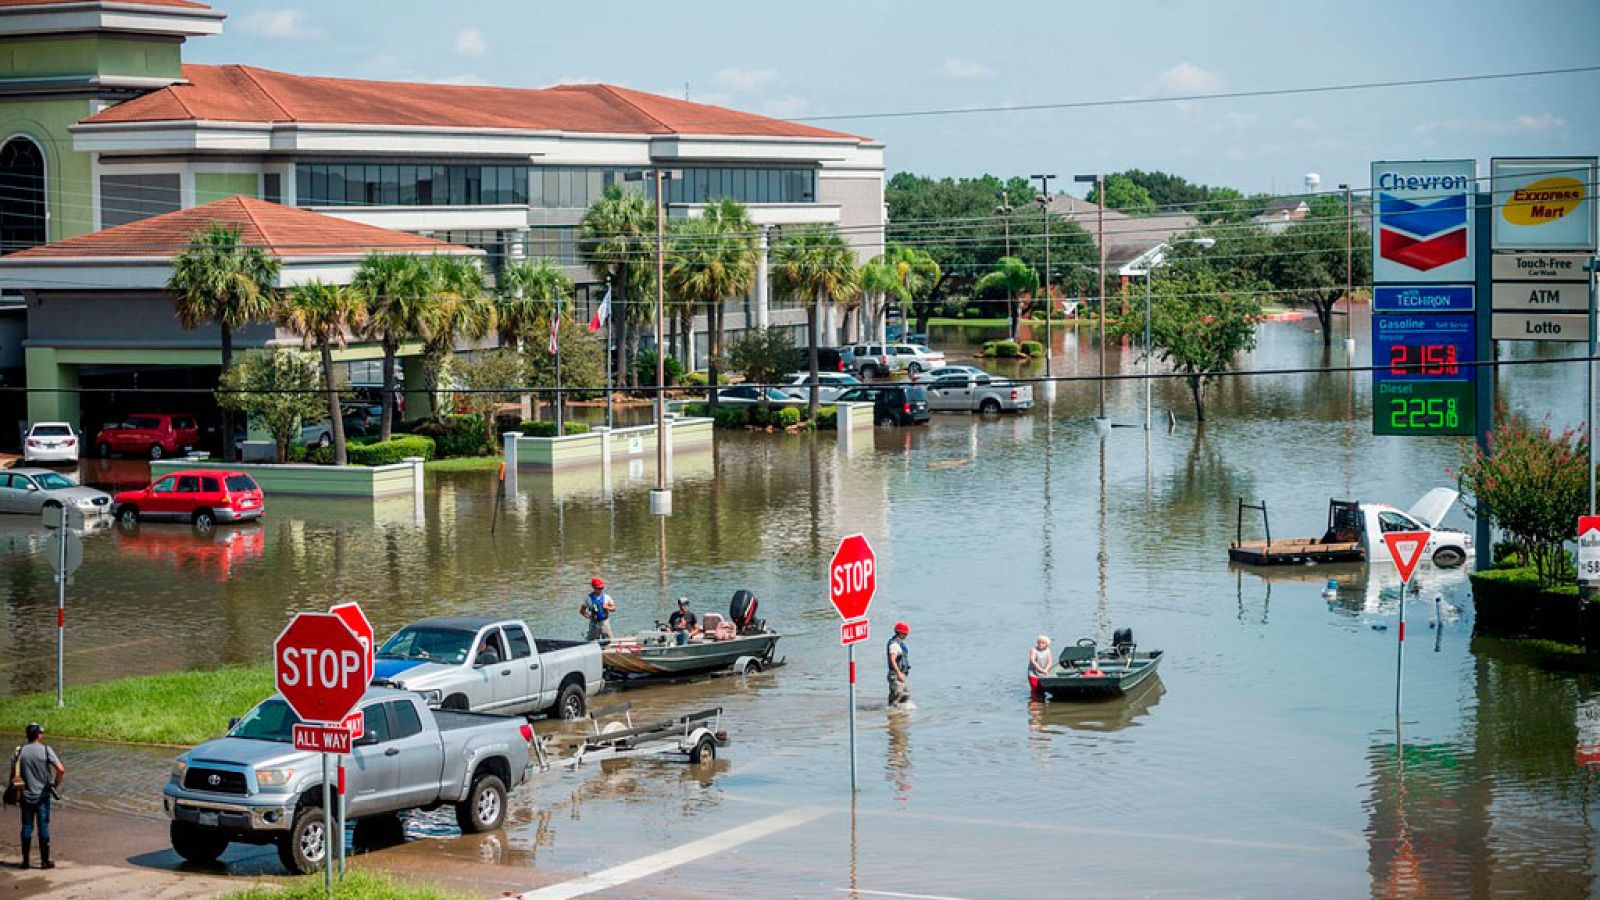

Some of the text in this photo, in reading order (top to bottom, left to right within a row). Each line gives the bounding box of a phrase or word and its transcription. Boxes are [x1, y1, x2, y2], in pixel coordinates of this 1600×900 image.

[1379, 172, 1467, 191] Chevron
[1513, 189, 1580, 203] Exxpress
[1530, 205, 1564, 218] Mart
[1516, 257, 1572, 269] Touch-Free
[1528, 289, 1560, 304] ATM
[1379, 319, 1425, 329] Gasoline
[1526, 320, 1562, 334] Lotto
[1379, 383, 1413, 393] Diesel
[833, 559, 873, 596] STOP
[843, 627, 854, 640] ALL
[282, 646, 360, 688] STOP
[296, 731, 348, 749] ALL WAY
